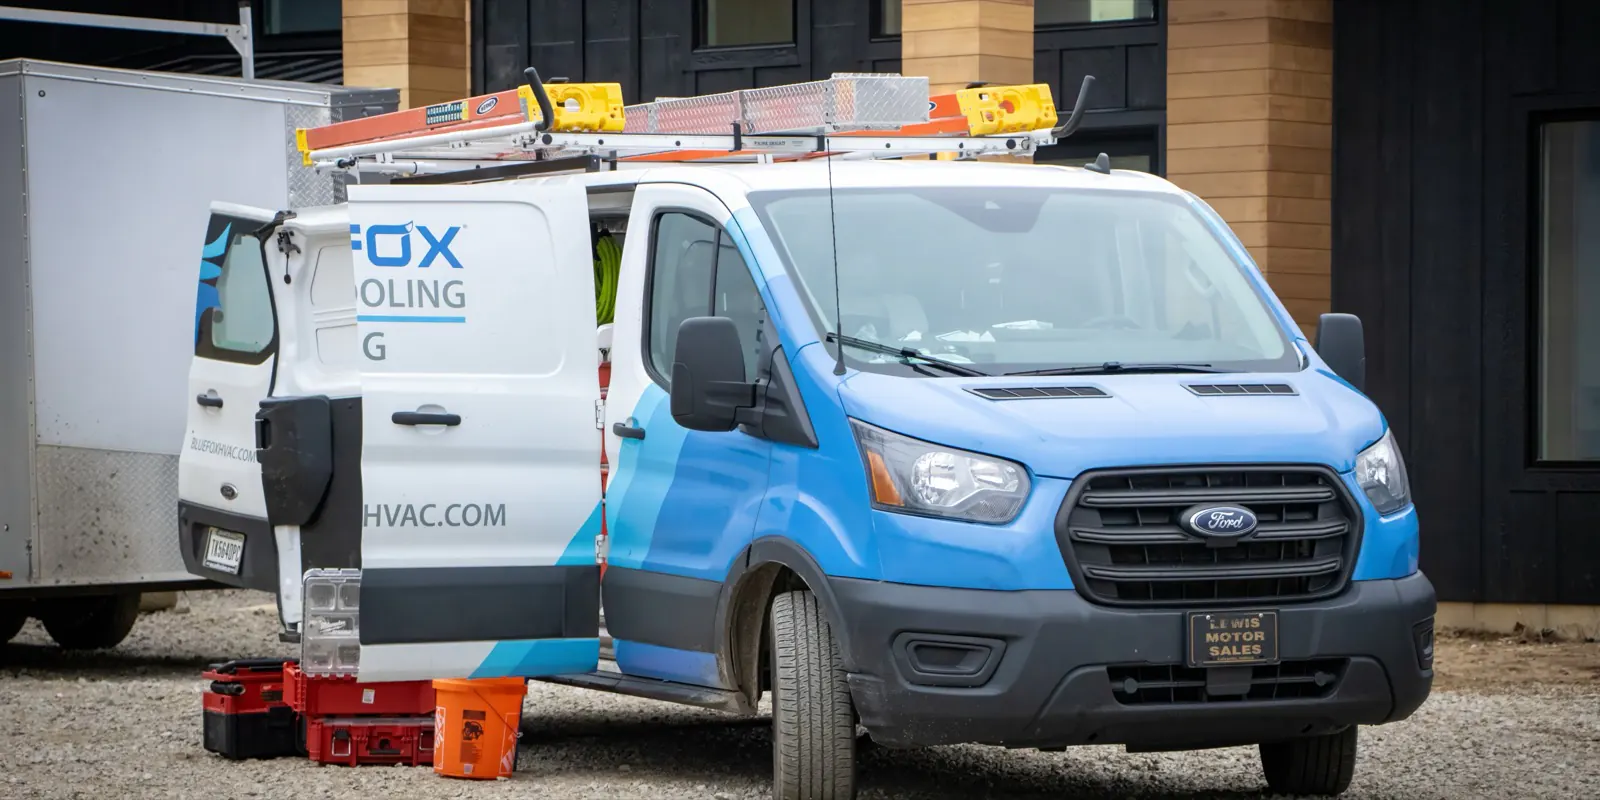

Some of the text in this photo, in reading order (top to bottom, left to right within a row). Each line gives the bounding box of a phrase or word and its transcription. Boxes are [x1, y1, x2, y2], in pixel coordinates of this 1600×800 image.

[355, 278, 466, 308] OLING
[190, 437, 257, 463] BLUEFOXHVAC.COM
[363, 503, 507, 527] HVAC.COM
[1208, 511, 1244, 529] Ford
[1205, 631, 1265, 643] MOTOR
[1209, 644, 1262, 656] SALES
